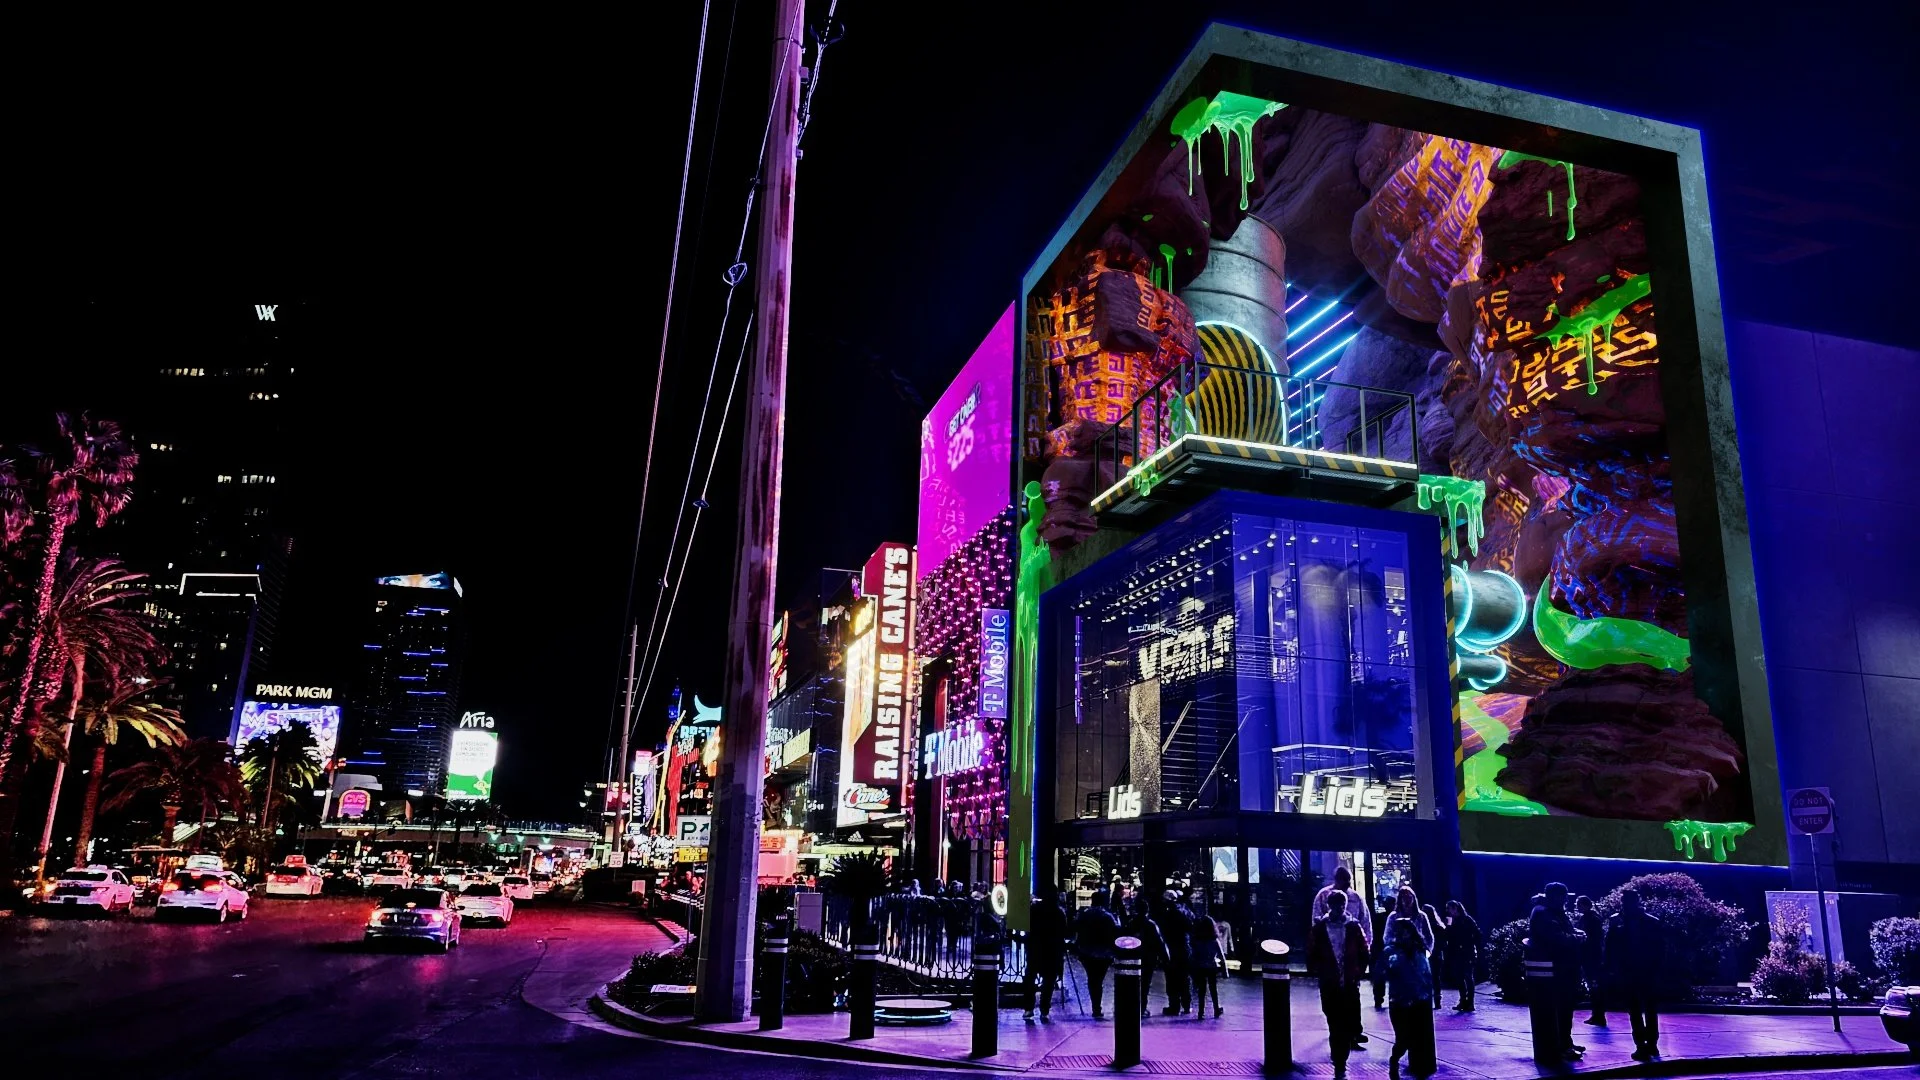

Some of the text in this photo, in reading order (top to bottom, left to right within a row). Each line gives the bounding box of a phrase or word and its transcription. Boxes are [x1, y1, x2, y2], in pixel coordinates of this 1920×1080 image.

[873, 547, 909, 780] RAISING CANE'S
[256, 684, 333, 700] PARK MGM
[459, 711, 495, 728] Aria
[345, 793, 367, 804] CVS
[633, 775, 644, 817] ROSS
[1108, 784, 1142, 819] Lids
[1299, 773, 1388, 818] Lids
[1793, 797, 1823, 806] DO NOT
[1799, 816, 1823, 825] ENTER
